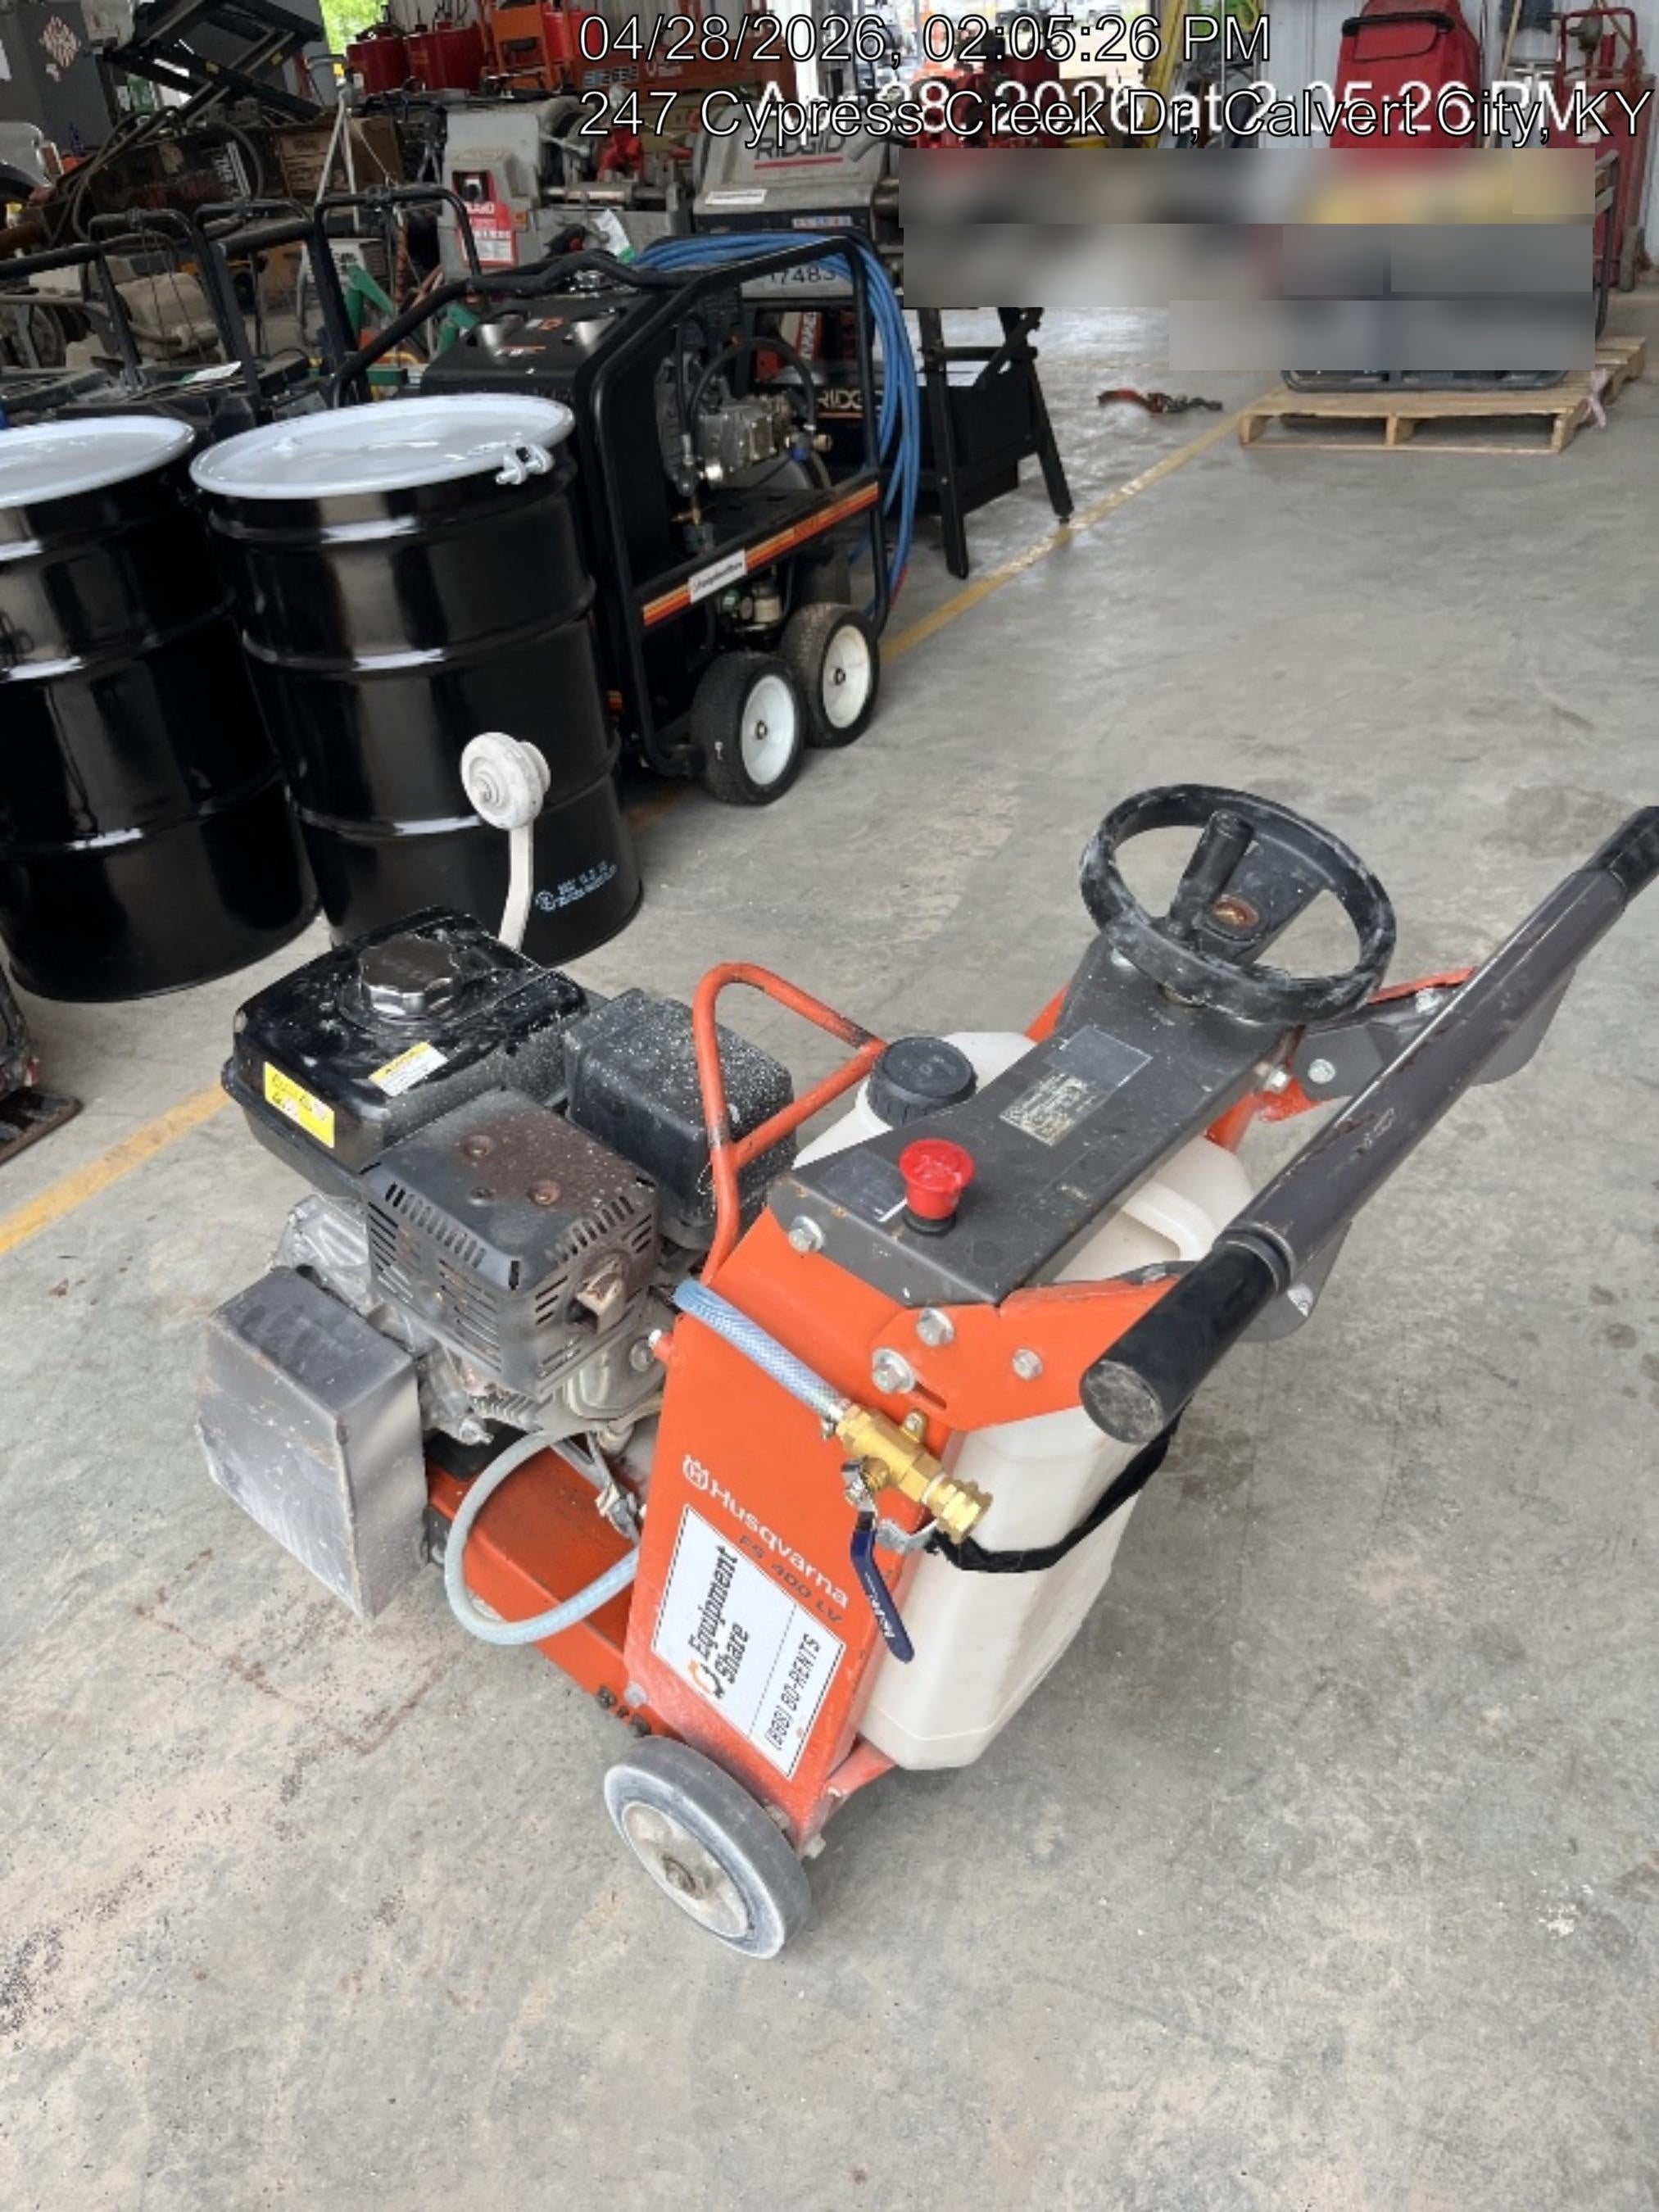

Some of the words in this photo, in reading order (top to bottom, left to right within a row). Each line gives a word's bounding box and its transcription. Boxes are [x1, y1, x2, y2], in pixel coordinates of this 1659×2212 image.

[710, 1479, 849, 1609] Husqvarna
[739, 1534, 765, 1559] FS
[772, 1564, 812, 1598] 400
[687, 1545, 738, 1662] Equipment
[714, 1622, 750, 1684] Share
